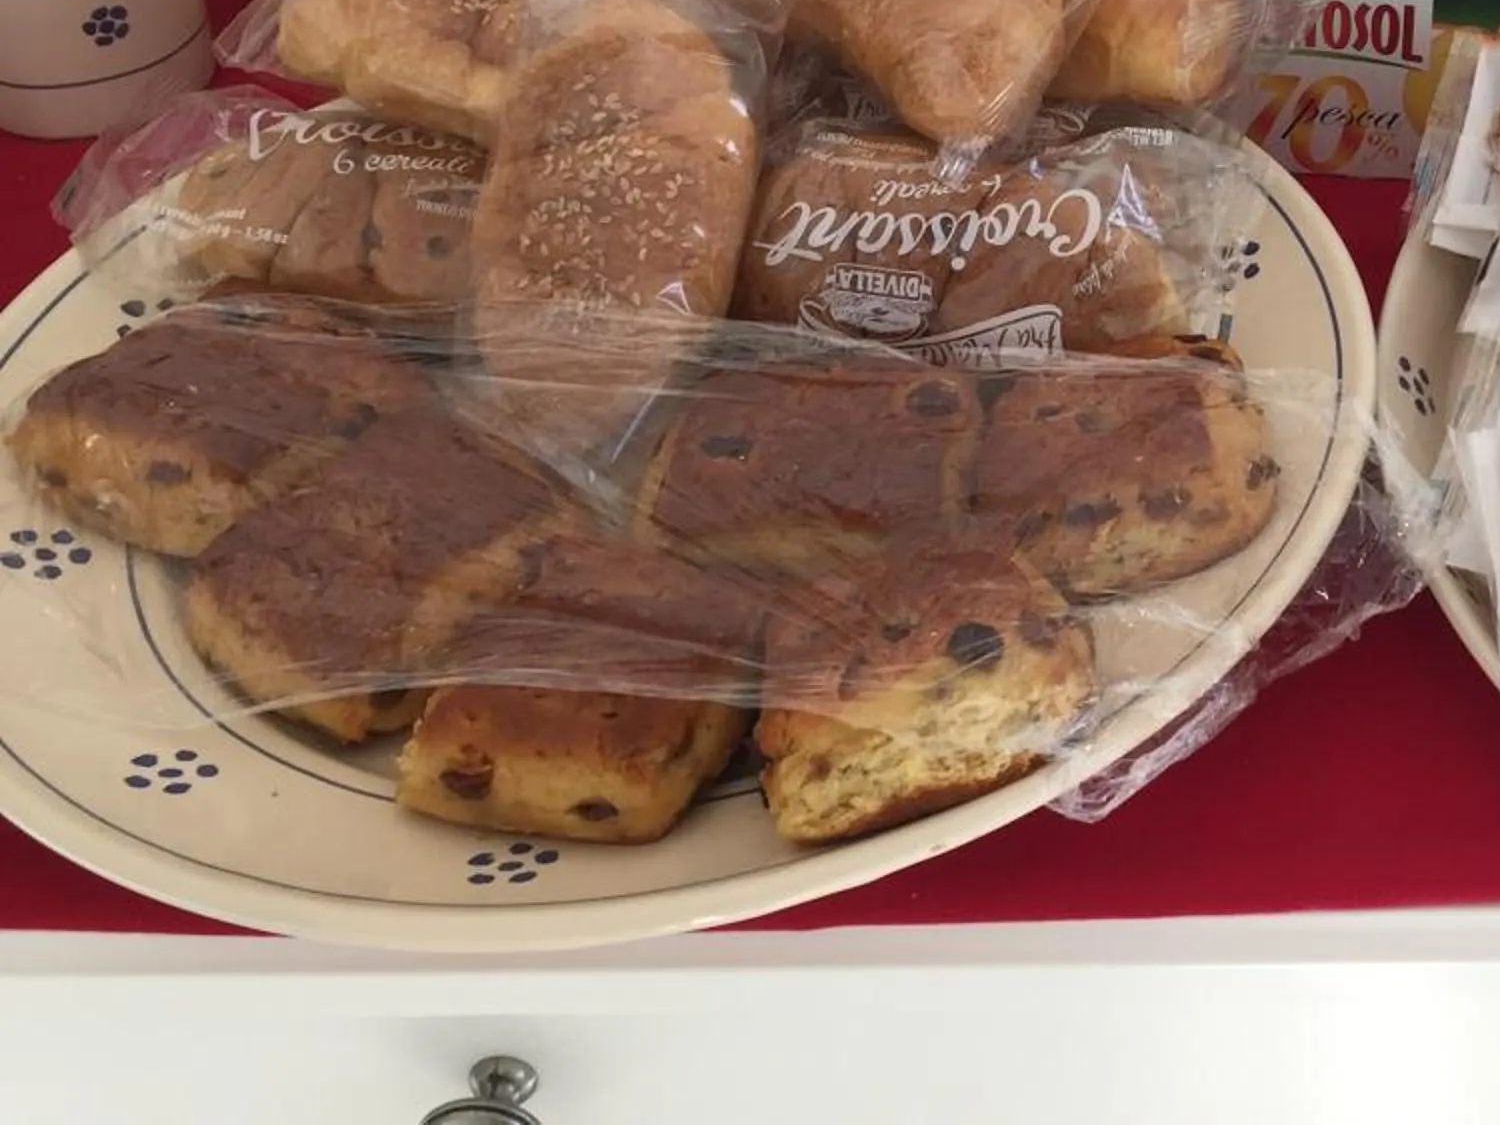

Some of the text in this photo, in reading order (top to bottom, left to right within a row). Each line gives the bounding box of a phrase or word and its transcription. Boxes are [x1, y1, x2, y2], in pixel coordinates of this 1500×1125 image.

[1281, 98, 1405, 140] pesca
[333, 152, 476, 175] 6 cereali
[752, 187, 1102, 272] Croissant
[836, 266, 921, 299] DIVELLA
